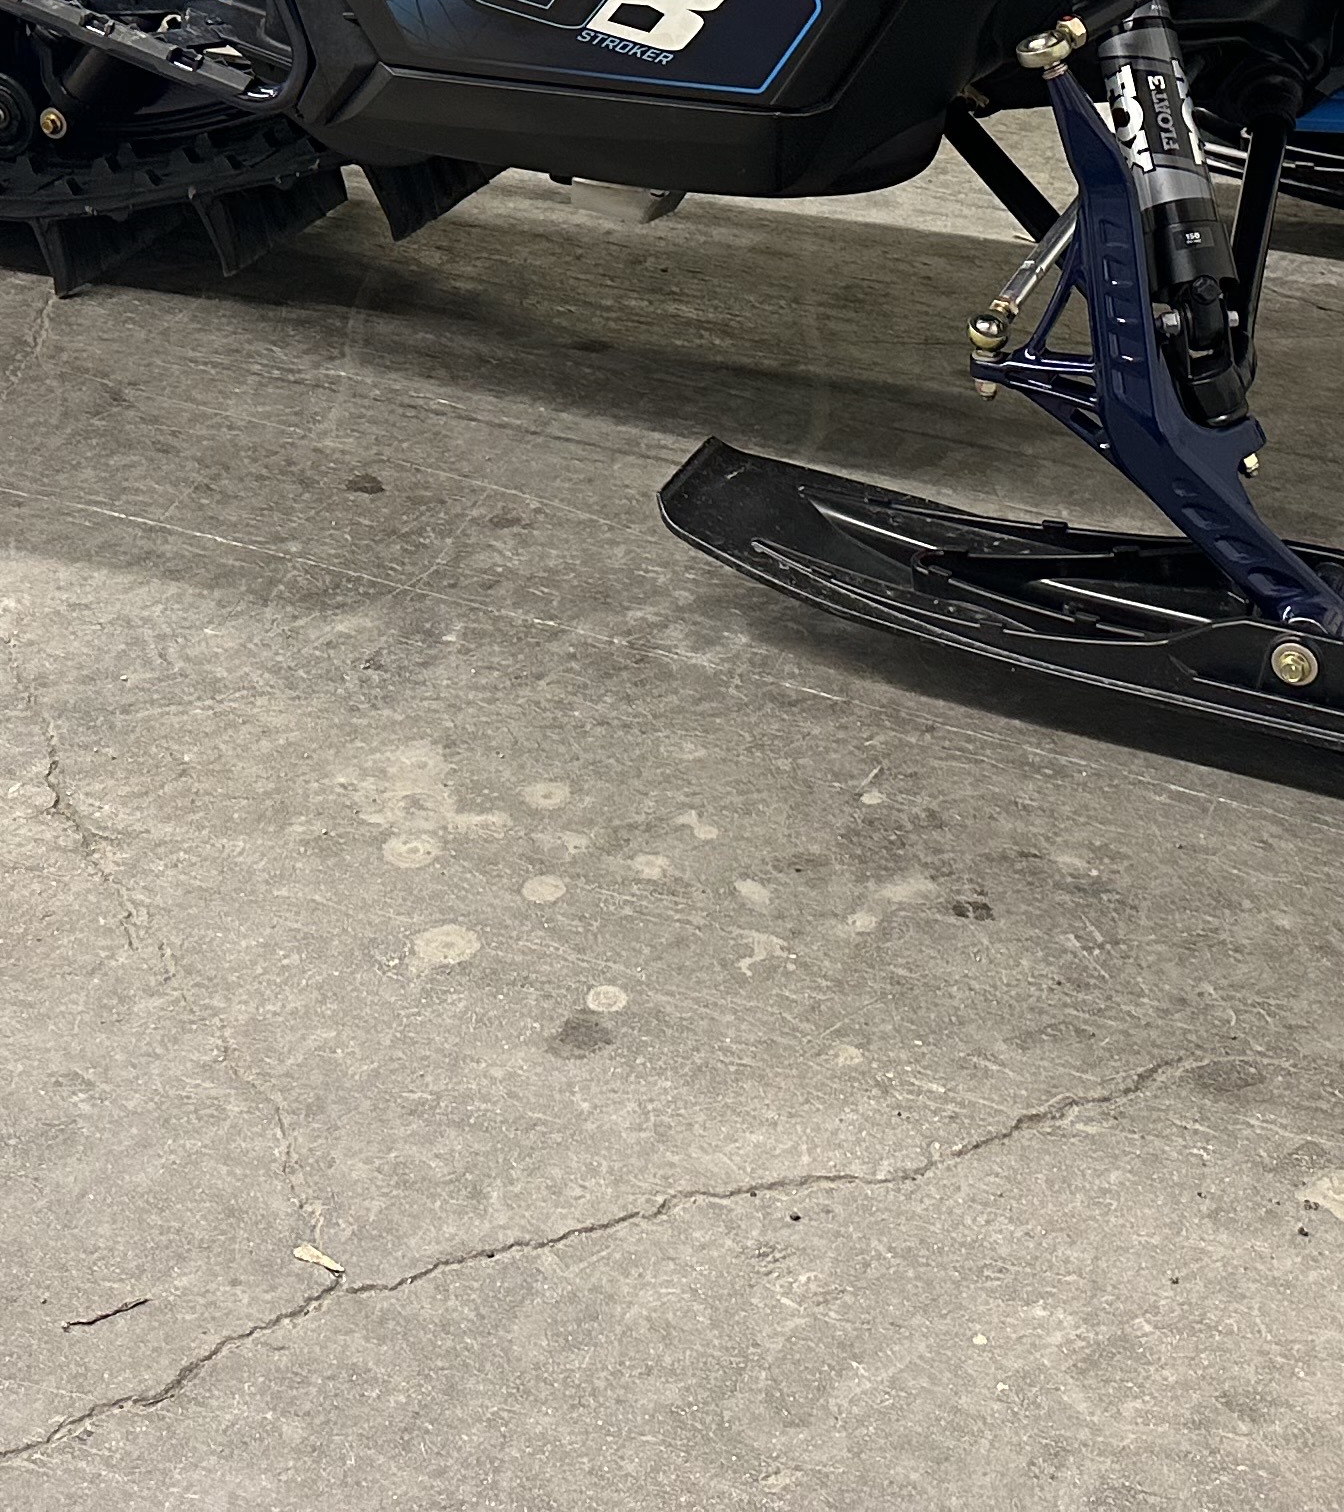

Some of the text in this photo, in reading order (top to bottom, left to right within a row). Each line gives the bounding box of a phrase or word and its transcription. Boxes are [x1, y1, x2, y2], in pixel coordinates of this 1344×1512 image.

[576, 30, 675, 66] STROKER
[1147, 75, 1180, 152] FLOAT 3
